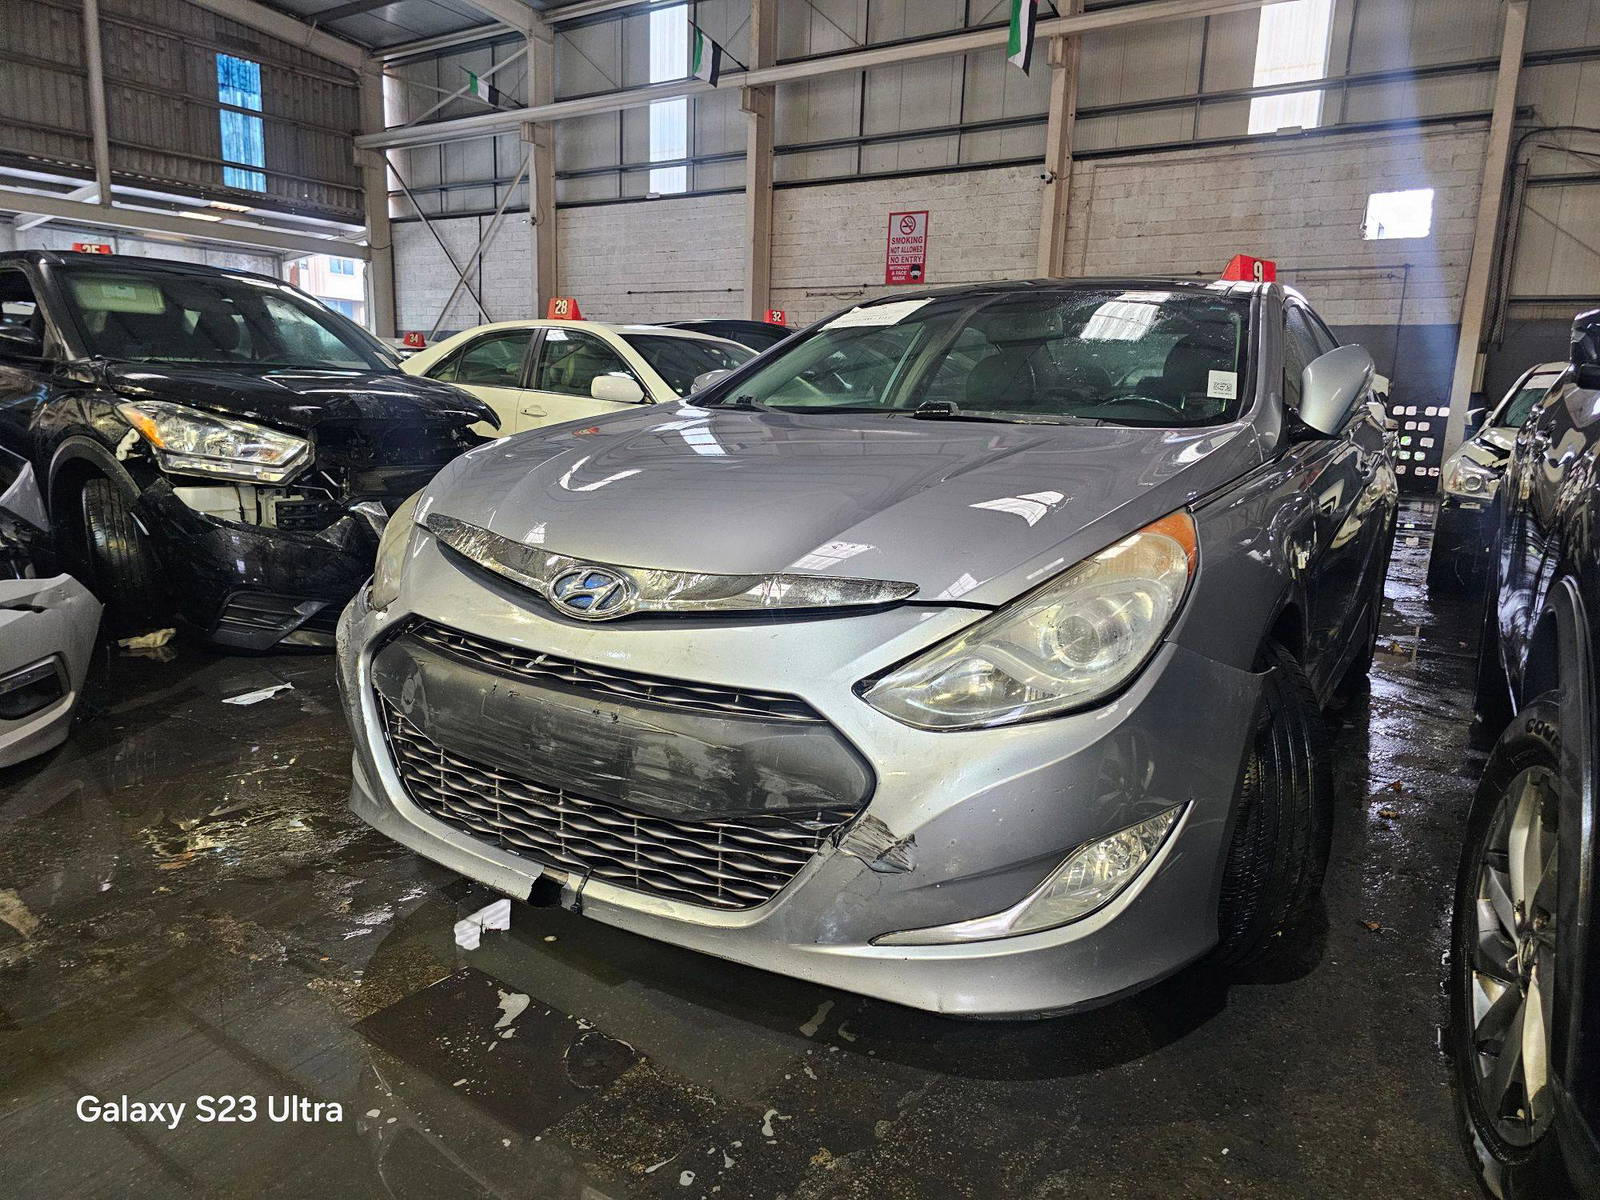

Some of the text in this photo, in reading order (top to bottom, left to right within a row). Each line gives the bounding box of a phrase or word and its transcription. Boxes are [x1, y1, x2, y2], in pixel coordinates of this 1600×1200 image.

[891, 236, 923, 245] SMOKING
[890, 245, 923, 254] NOT ALLOWED
[1253, 261, 1263, 283] 9
[555, 300, 568, 315] 28
[772, 311, 782, 322] 32
